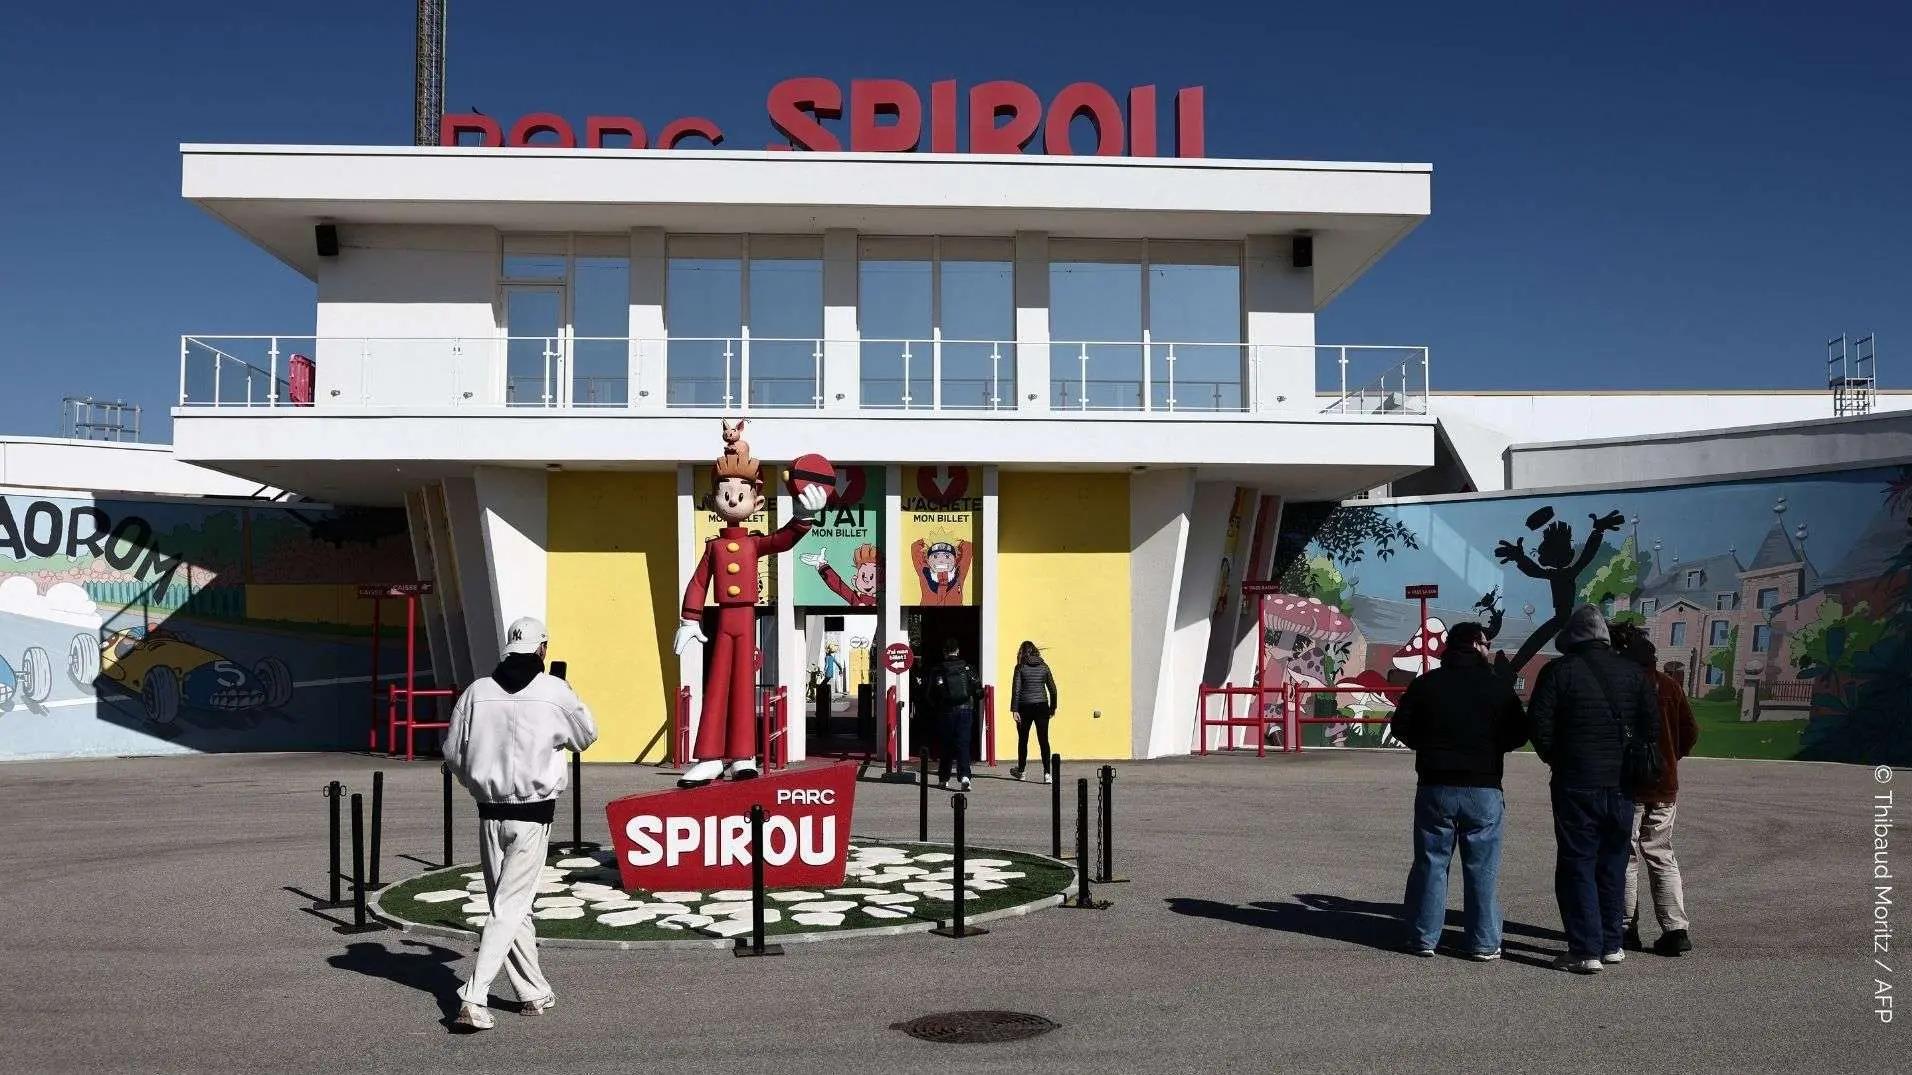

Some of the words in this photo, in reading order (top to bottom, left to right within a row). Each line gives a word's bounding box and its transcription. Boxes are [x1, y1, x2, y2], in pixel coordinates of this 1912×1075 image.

[767, 77, 1206, 158] SPIROU
[708, 514, 727, 522] MO
[811, 503, 865, 528] J'AI
[913, 514, 935, 523] MON
[937, 514, 969, 523] BILLET
[811, 528, 833, 537] MON
[835, 528, 868, 537] BILLET
[777, 788, 836, 805] PARC
[625, 814, 836, 868] SPIROU
